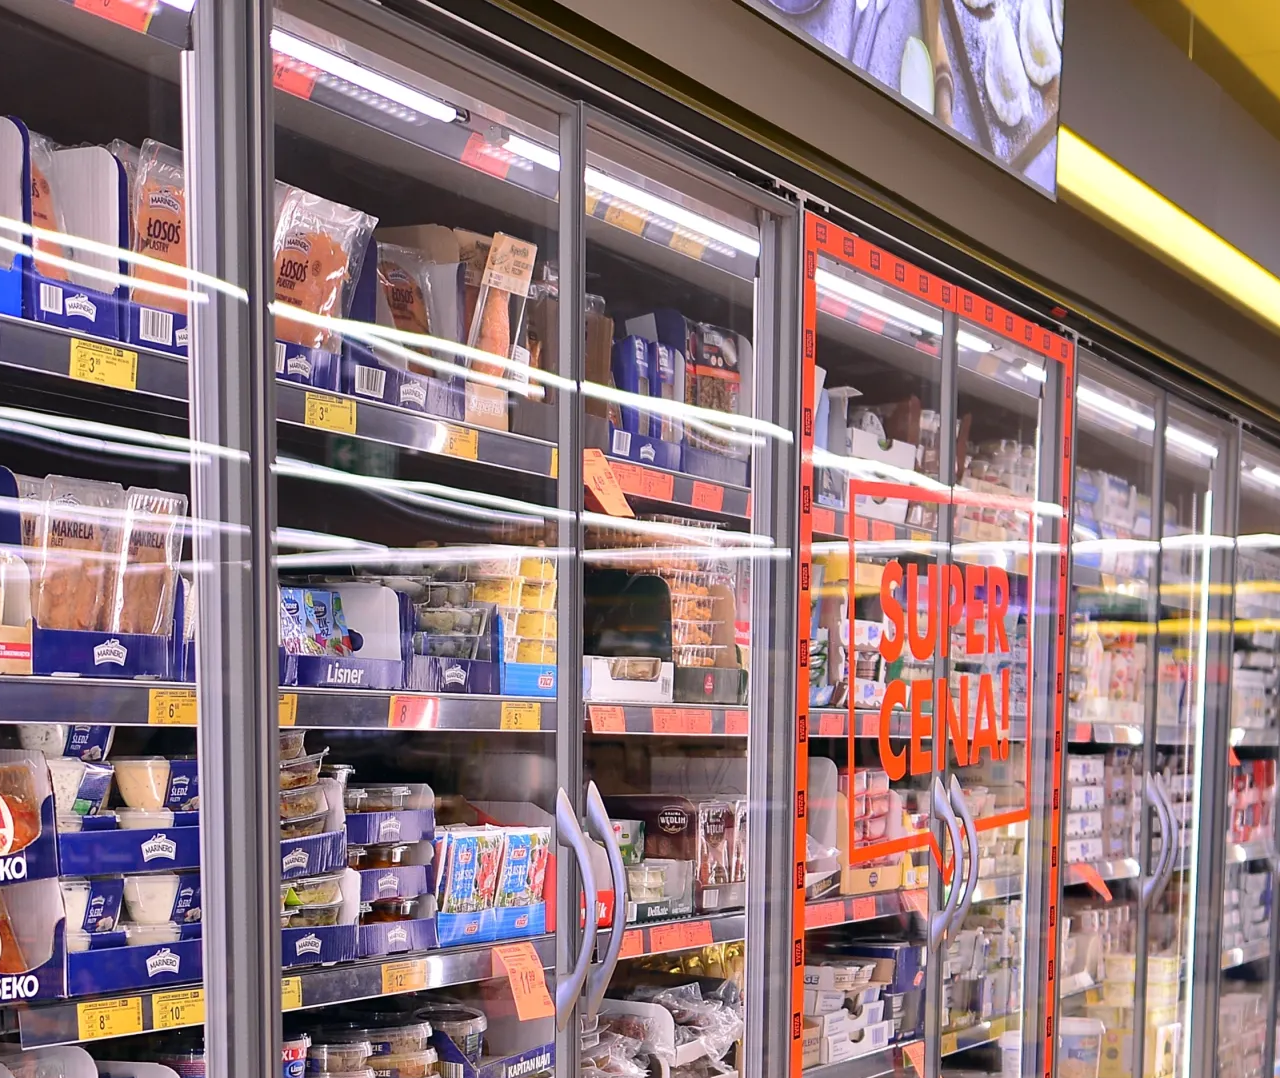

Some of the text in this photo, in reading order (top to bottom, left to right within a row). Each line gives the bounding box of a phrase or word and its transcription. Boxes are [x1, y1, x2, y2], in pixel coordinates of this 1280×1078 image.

[151, 196, 179, 212] MARINERO
[147, 218, 180, 244] ŁOSOŚ
[280, 258, 309, 283] ŁOSOŚ
[67, 301, 94, 317] MARINERO
[89, 357, 95, 373] 3
[52, 519, 94, 540] MAKRELA
[130, 529, 164, 549] MAKRELA
[879, 560, 1010, 663] SUPER
[97, 648, 123, 658] MARINERO
[327, 662, 364, 685] Lisner
[879, 668, 1010, 782] CENA!
[72, 733, 89, 744] ŚLEDŹ
[171, 785, 188, 796] ŚLEDŹ
[144, 845, 173, 855] MARINERO
[284, 856, 307, 867] MARINERO
[89, 906, 104, 918] ŚLEDŹ
[296, 941, 320, 950] MARINERO
[150, 959, 177, 968] MARINERO
[170, 1006, 180, 1020] 10
[99, 1015, 105, 1030] 8
[507, 1053, 550, 1078] KAPITAN NAVI
